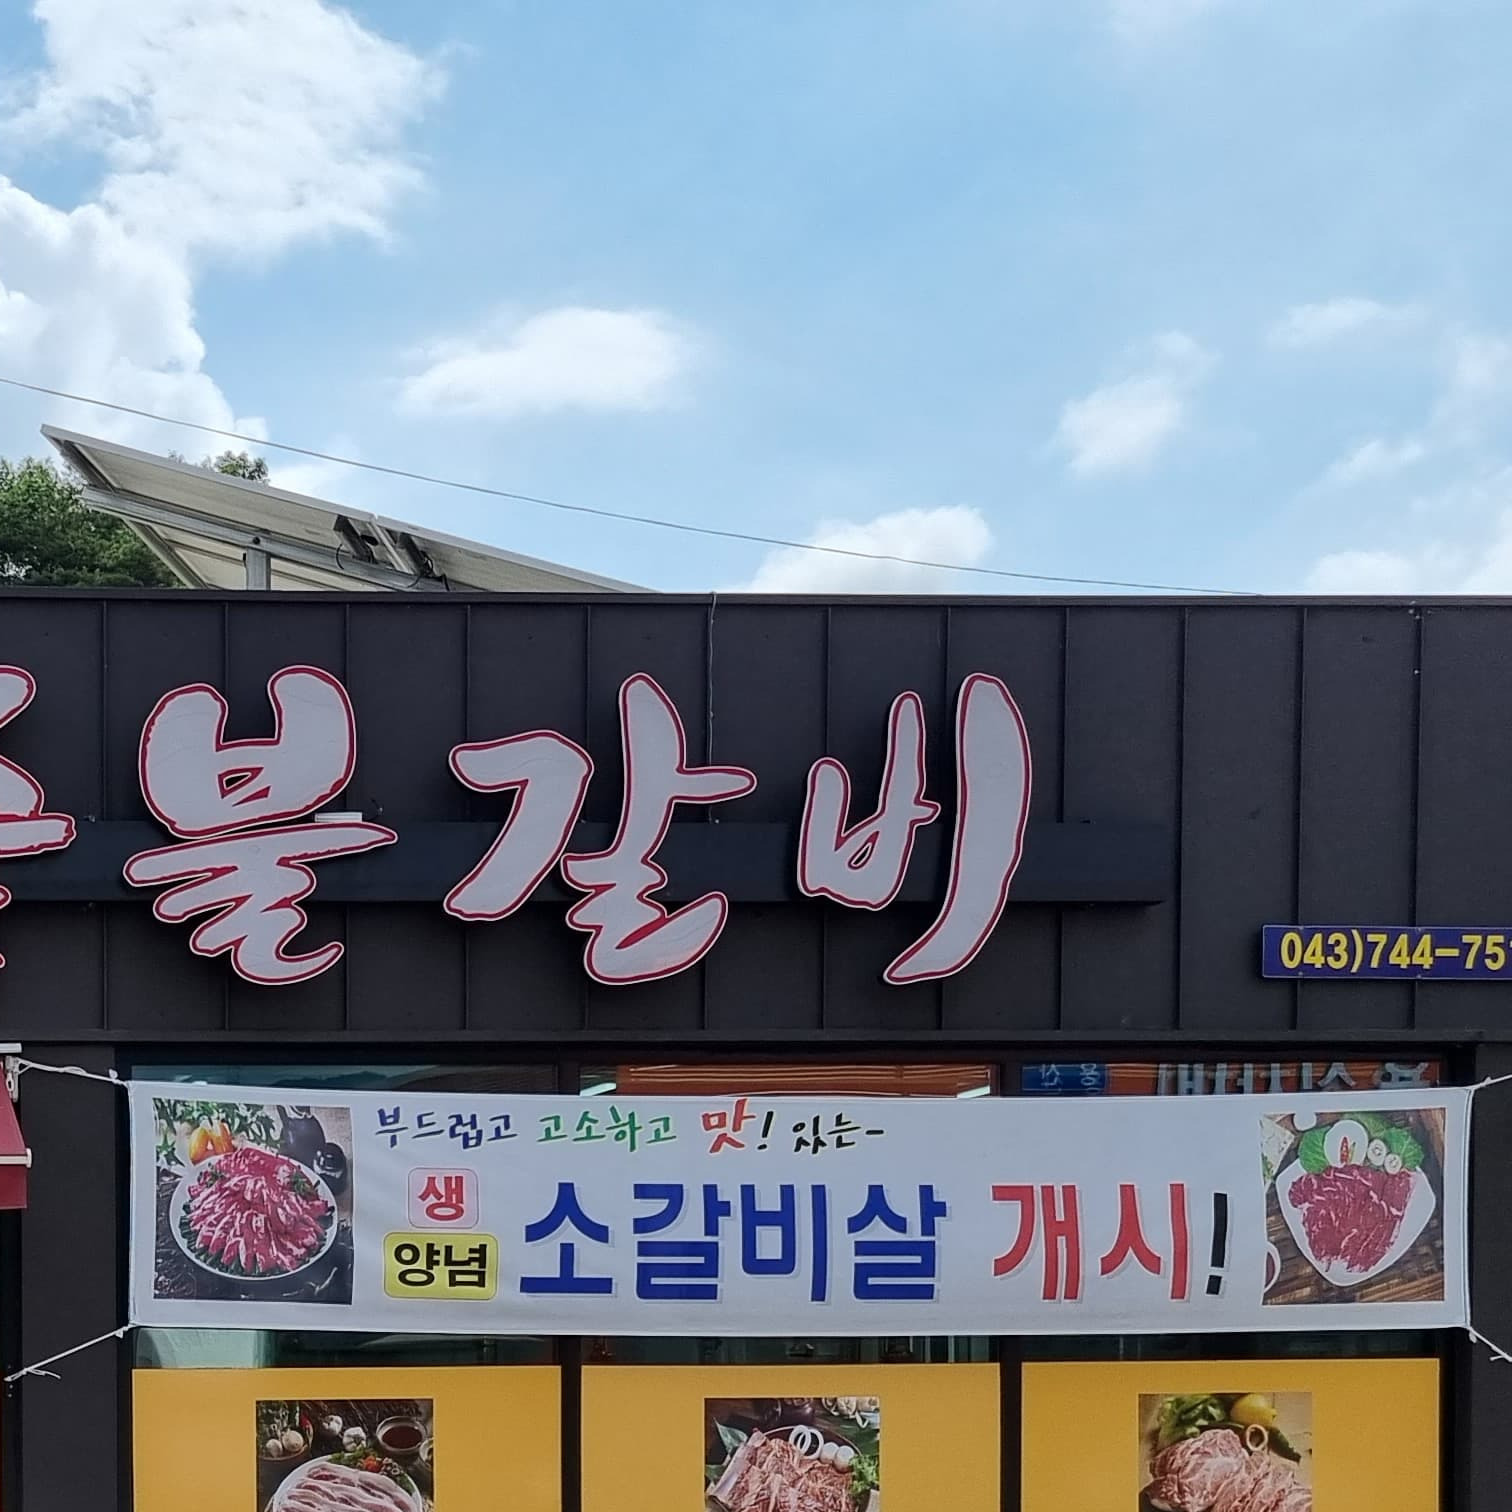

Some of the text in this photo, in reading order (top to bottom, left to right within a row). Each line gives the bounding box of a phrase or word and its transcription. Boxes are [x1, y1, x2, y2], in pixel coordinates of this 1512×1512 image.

[1280, 929, 1512, 973] 043)744-75
[374, 1107, 518, 1149] 부드럽고
[537, 1106, 677, 1152] 고소하고
[418, 1175, 465, 1221] 생
[393, 1241, 488, 1289] 양념
[520, 1182, 1228, 1302] 소갈비살 개시!
